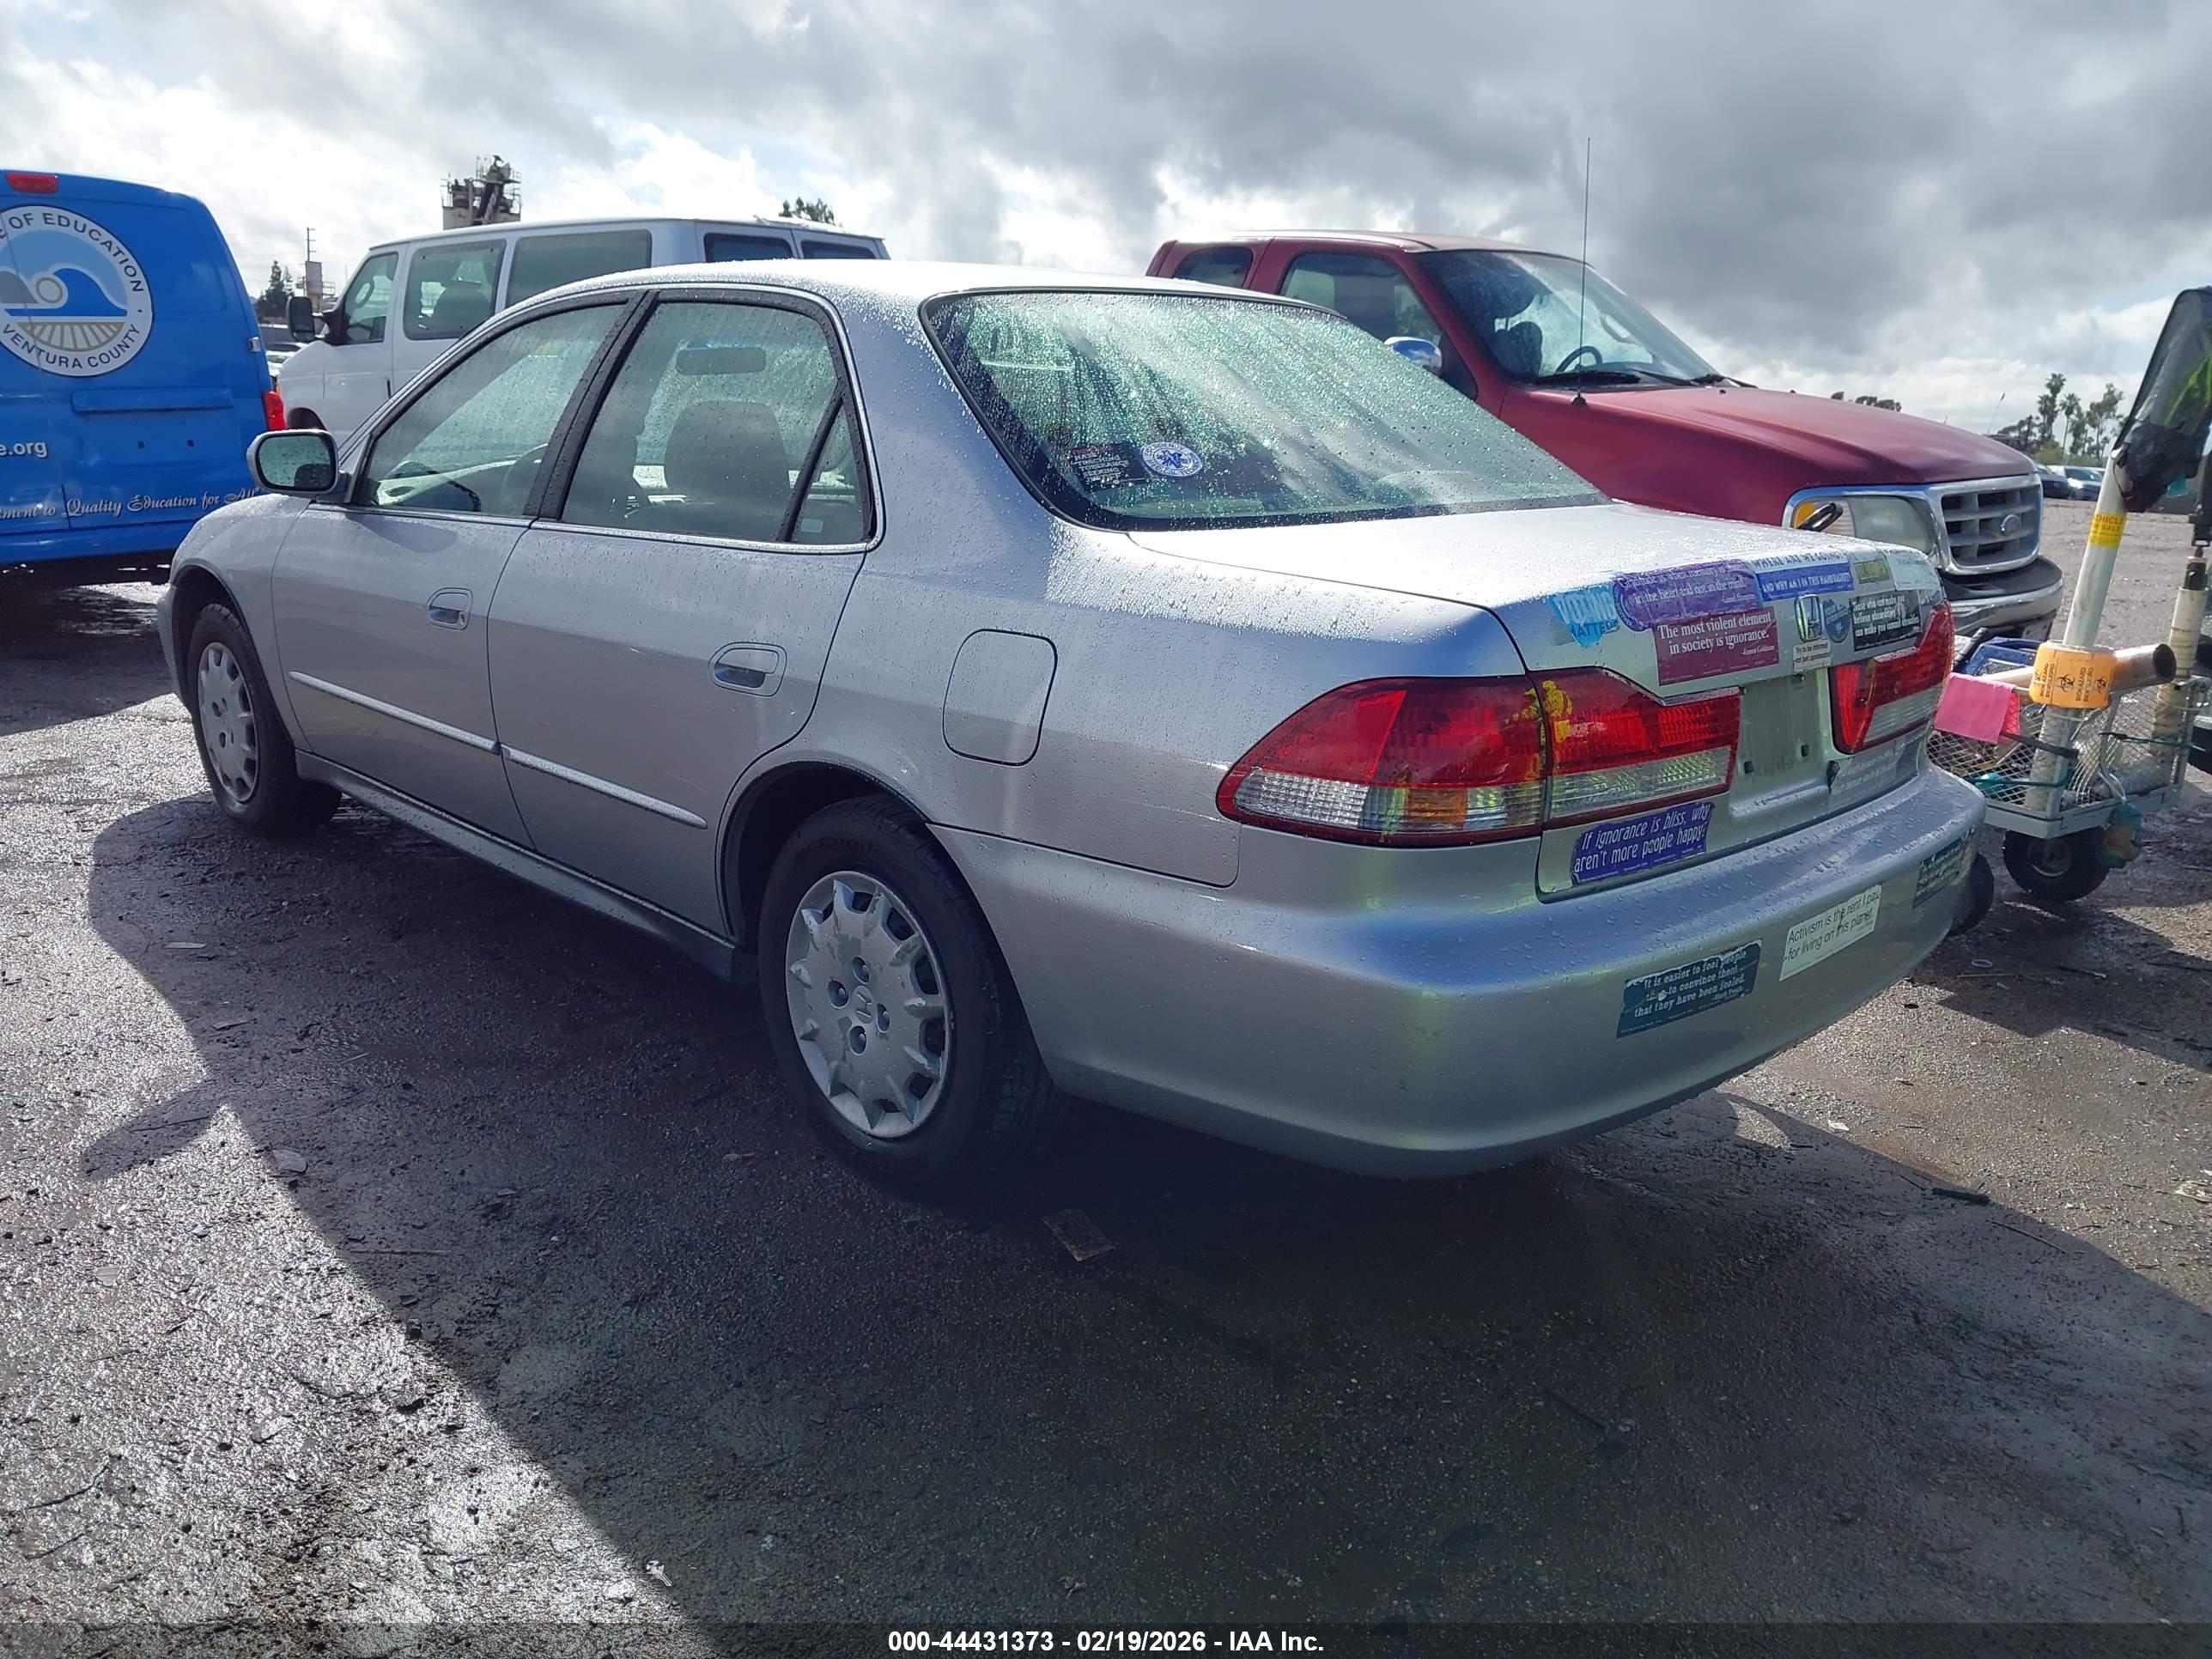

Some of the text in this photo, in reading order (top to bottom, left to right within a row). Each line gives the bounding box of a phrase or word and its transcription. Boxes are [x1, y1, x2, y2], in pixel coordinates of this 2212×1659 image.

[9, 212, 144, 292] OF EDUCATION
[3, 324, 140, 368] VENTURA COUNTY
[62, 498, 122, 518] Quality
[127, 494, 198, 512] Education
[202, 491, 220, 509] for
[1751, 556, 1784, 568] WHERE
[1785, 554, 1802, 564] ARE
[1644, 589, 1659, 602] the
[1775, 580, 1788, 591] WHY
[1656, 611, 1771, 640] The most violent element
[1668, 629, 1770, 655] in society is ignorance.
[1581, 803, 1711, 851] If ignorance is bliss, why
[1574, 849, 1607, 873] aren't
[1611, 843, 1638, 866] more
[1787, 919, 1824, 944] Activism
[1825, 916, 1832, 927] is
[1833, 906, 1847, 921] the
[1845, 898, 1863, 915] rent
[1802, 934, 1823, 954] living
[1824, 929, 1836, 943] on
[1644, 978, 1653, 988] It
[1654, 975, 1662, 986] is
[1663, 968, 1691, 984] easier
[1692, 964, 1701, 975] to
[1702, 957, 1719, 973] fool
[1668, 985, 1678, 995] to
[1679, 975, 1717, 992] convince
[1634, 1004, 1653, 1018] that
[1654, 998, 1675, 1012] they
[1676, 990, 1697, 1006] have
[1698, 985, 1718, 998] been
